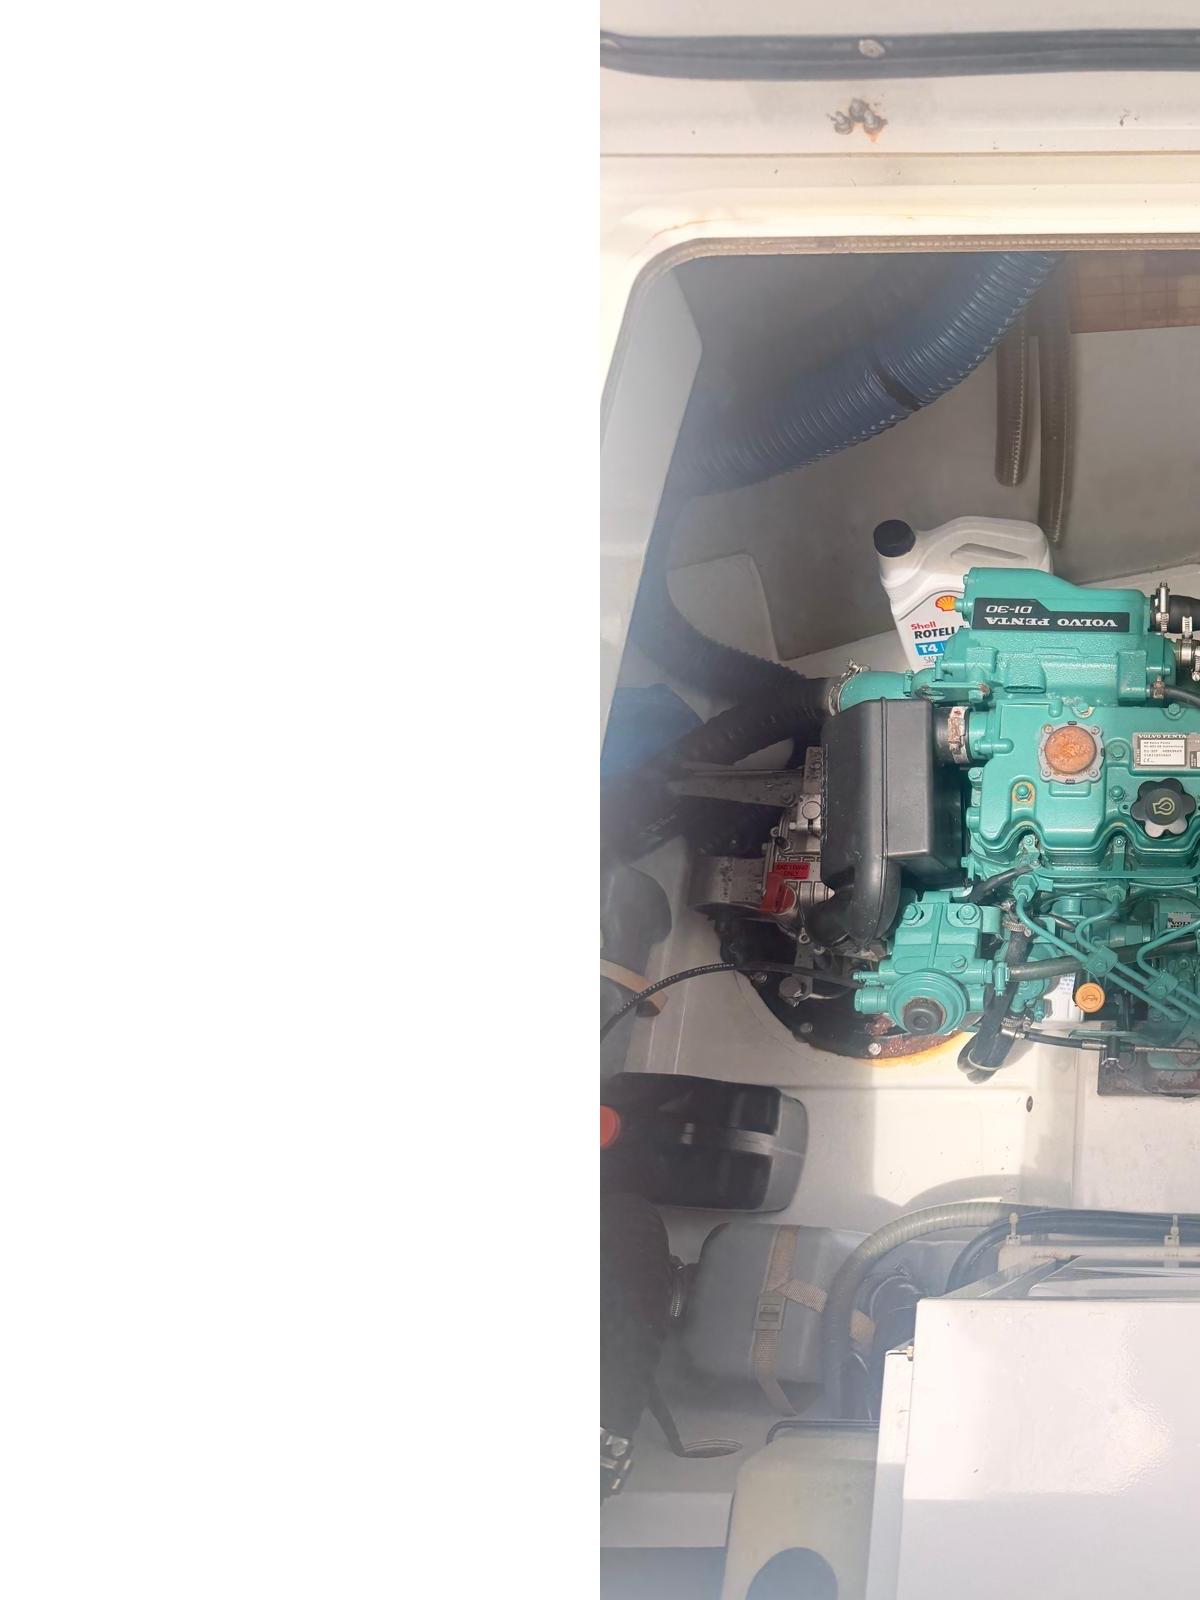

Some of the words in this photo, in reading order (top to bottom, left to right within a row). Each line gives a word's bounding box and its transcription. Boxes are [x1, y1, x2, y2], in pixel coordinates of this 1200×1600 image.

[911, 621, 937, 630] Shell
[984, 616, 1051, 627] PENTA
[1057, 618, 1119, 627] VOLVO
[914, 626, 964, 639] ROTELL
[918, 644, 939, 654] T4
